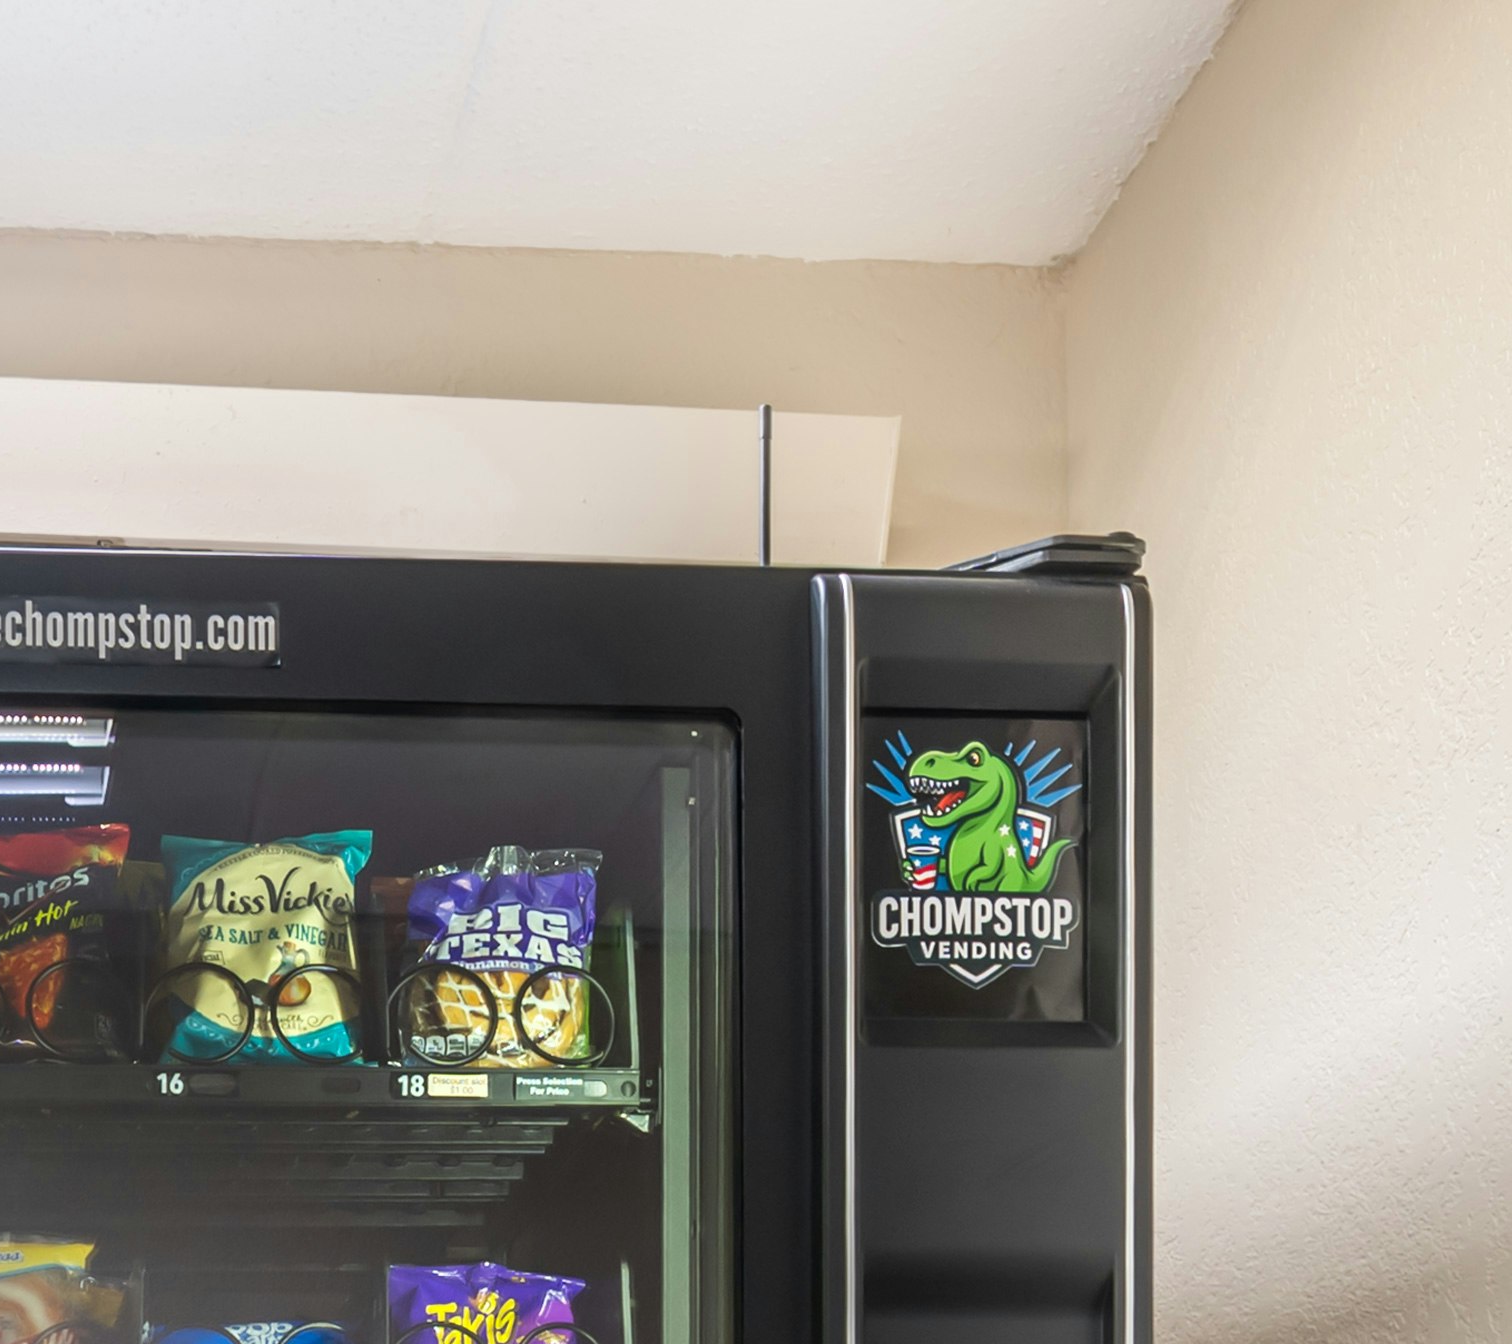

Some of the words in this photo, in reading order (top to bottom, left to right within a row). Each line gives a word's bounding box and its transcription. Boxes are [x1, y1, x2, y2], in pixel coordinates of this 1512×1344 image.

[185, 878, 264, 915] Miss
[448, 904, 568, 940] BIG
[879, 897, 1072, 940] CHOMPSTOP
[199, 925, 225, 941] SEA
[229, 928, 263, 944] SALT
[268, 928, 280, 940] &
[285, 924, 347, 949] VINEGAR
[429, 933, 583, 968] TEXAS
[921, 941, 1032, 959] VENDING
[157, 1074, 183, 1094] 16
[398, 1075, 424, 1097] 18
[432, 1076, 468, 1085] Discount
